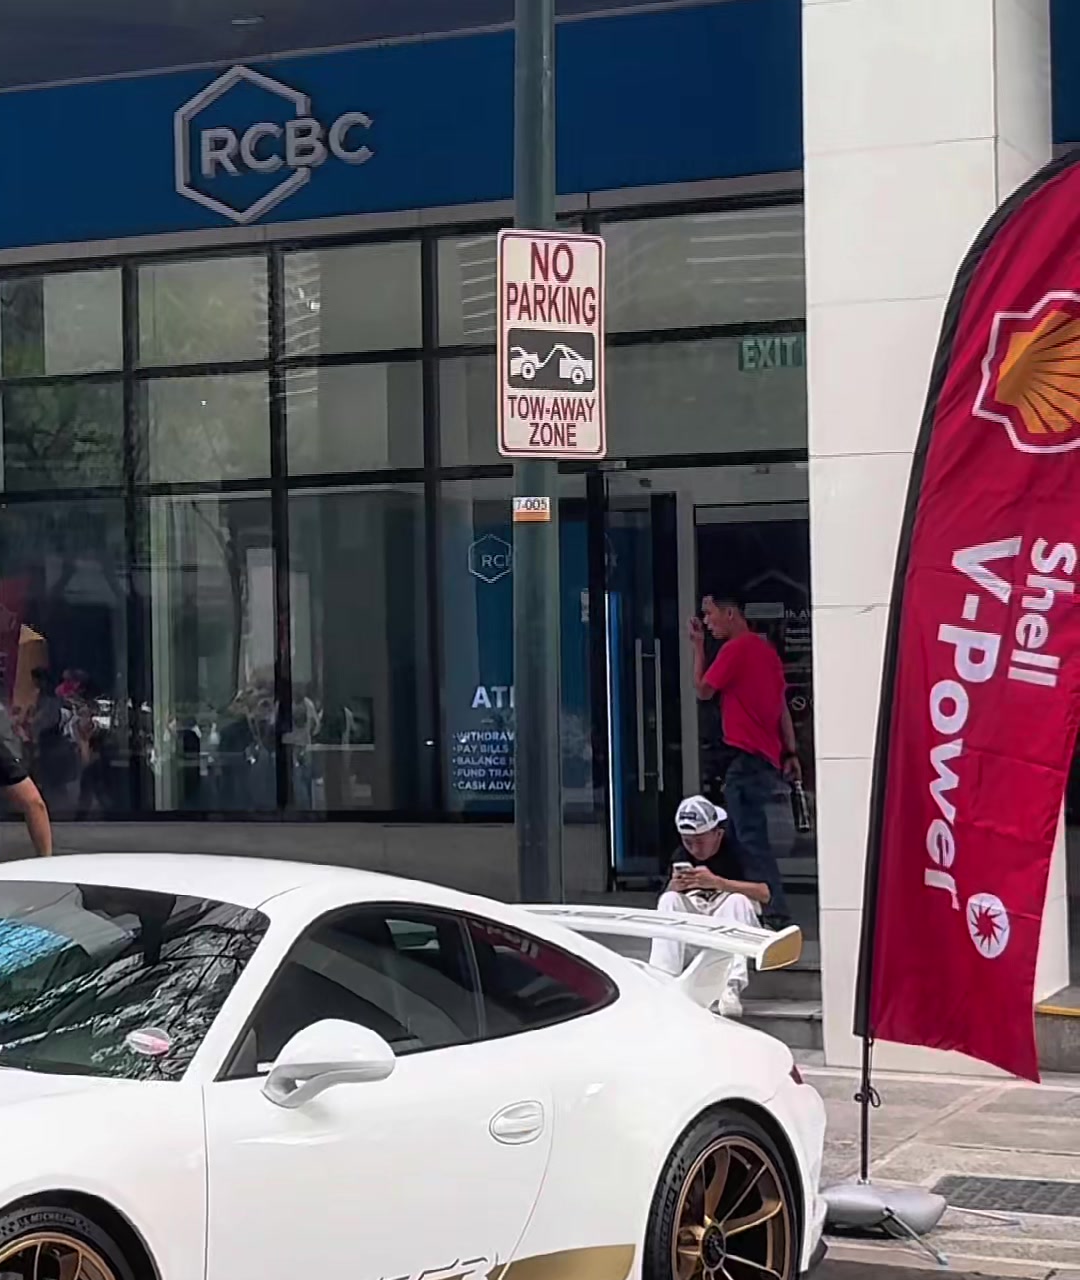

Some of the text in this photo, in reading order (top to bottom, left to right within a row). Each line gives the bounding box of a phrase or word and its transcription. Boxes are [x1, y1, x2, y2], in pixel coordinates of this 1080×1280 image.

[201, 111, 375, 178] RCBC
[530, 242, 574, 283] NO
[506, 283, 596, 326] PARKING
[743, 336, 797, 368] EXIT
[507, 396, 596, 423] TOW-AWAY
[529, 422, 577, 447] ZONE
[1008, 537, 1077, 687] Shell
[924, 535, 1023, 910] V-Power
[457, 744, 509, 754] PAY BILLS
[457, 756, 507, 766] BALANCE
[457, 768, 486, 778] FUND
[458, 780, 486, 791] CASH
